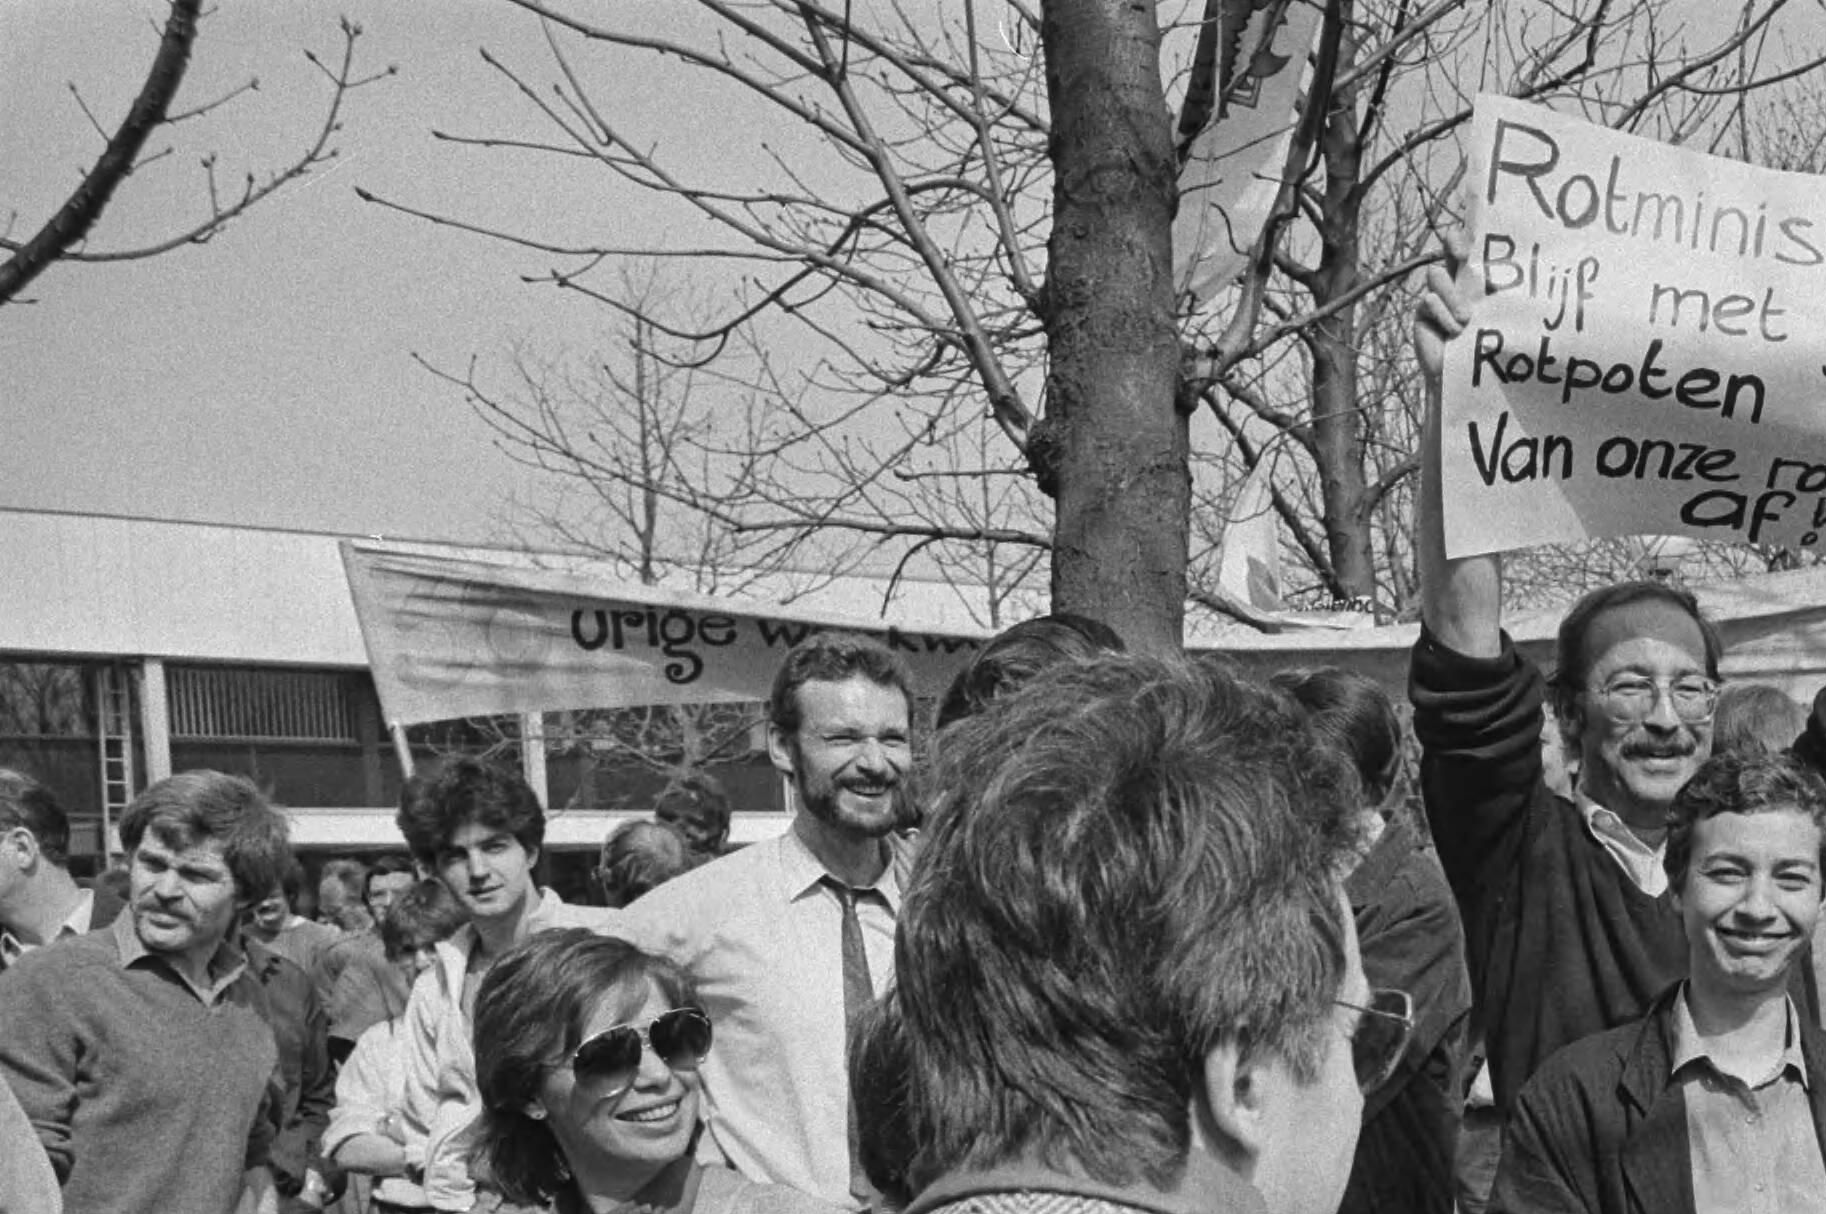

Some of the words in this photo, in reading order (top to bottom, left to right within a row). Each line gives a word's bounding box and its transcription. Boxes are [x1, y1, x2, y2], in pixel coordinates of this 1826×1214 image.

[1483, 234, 1600, 332] Blijf
[1649, 282, 1788, 342] met
[1472, 329, 1765, 424] Rotpoten
[1469, 412, 1573, 485] Van
[1597, 435, 1740, 482] onze
